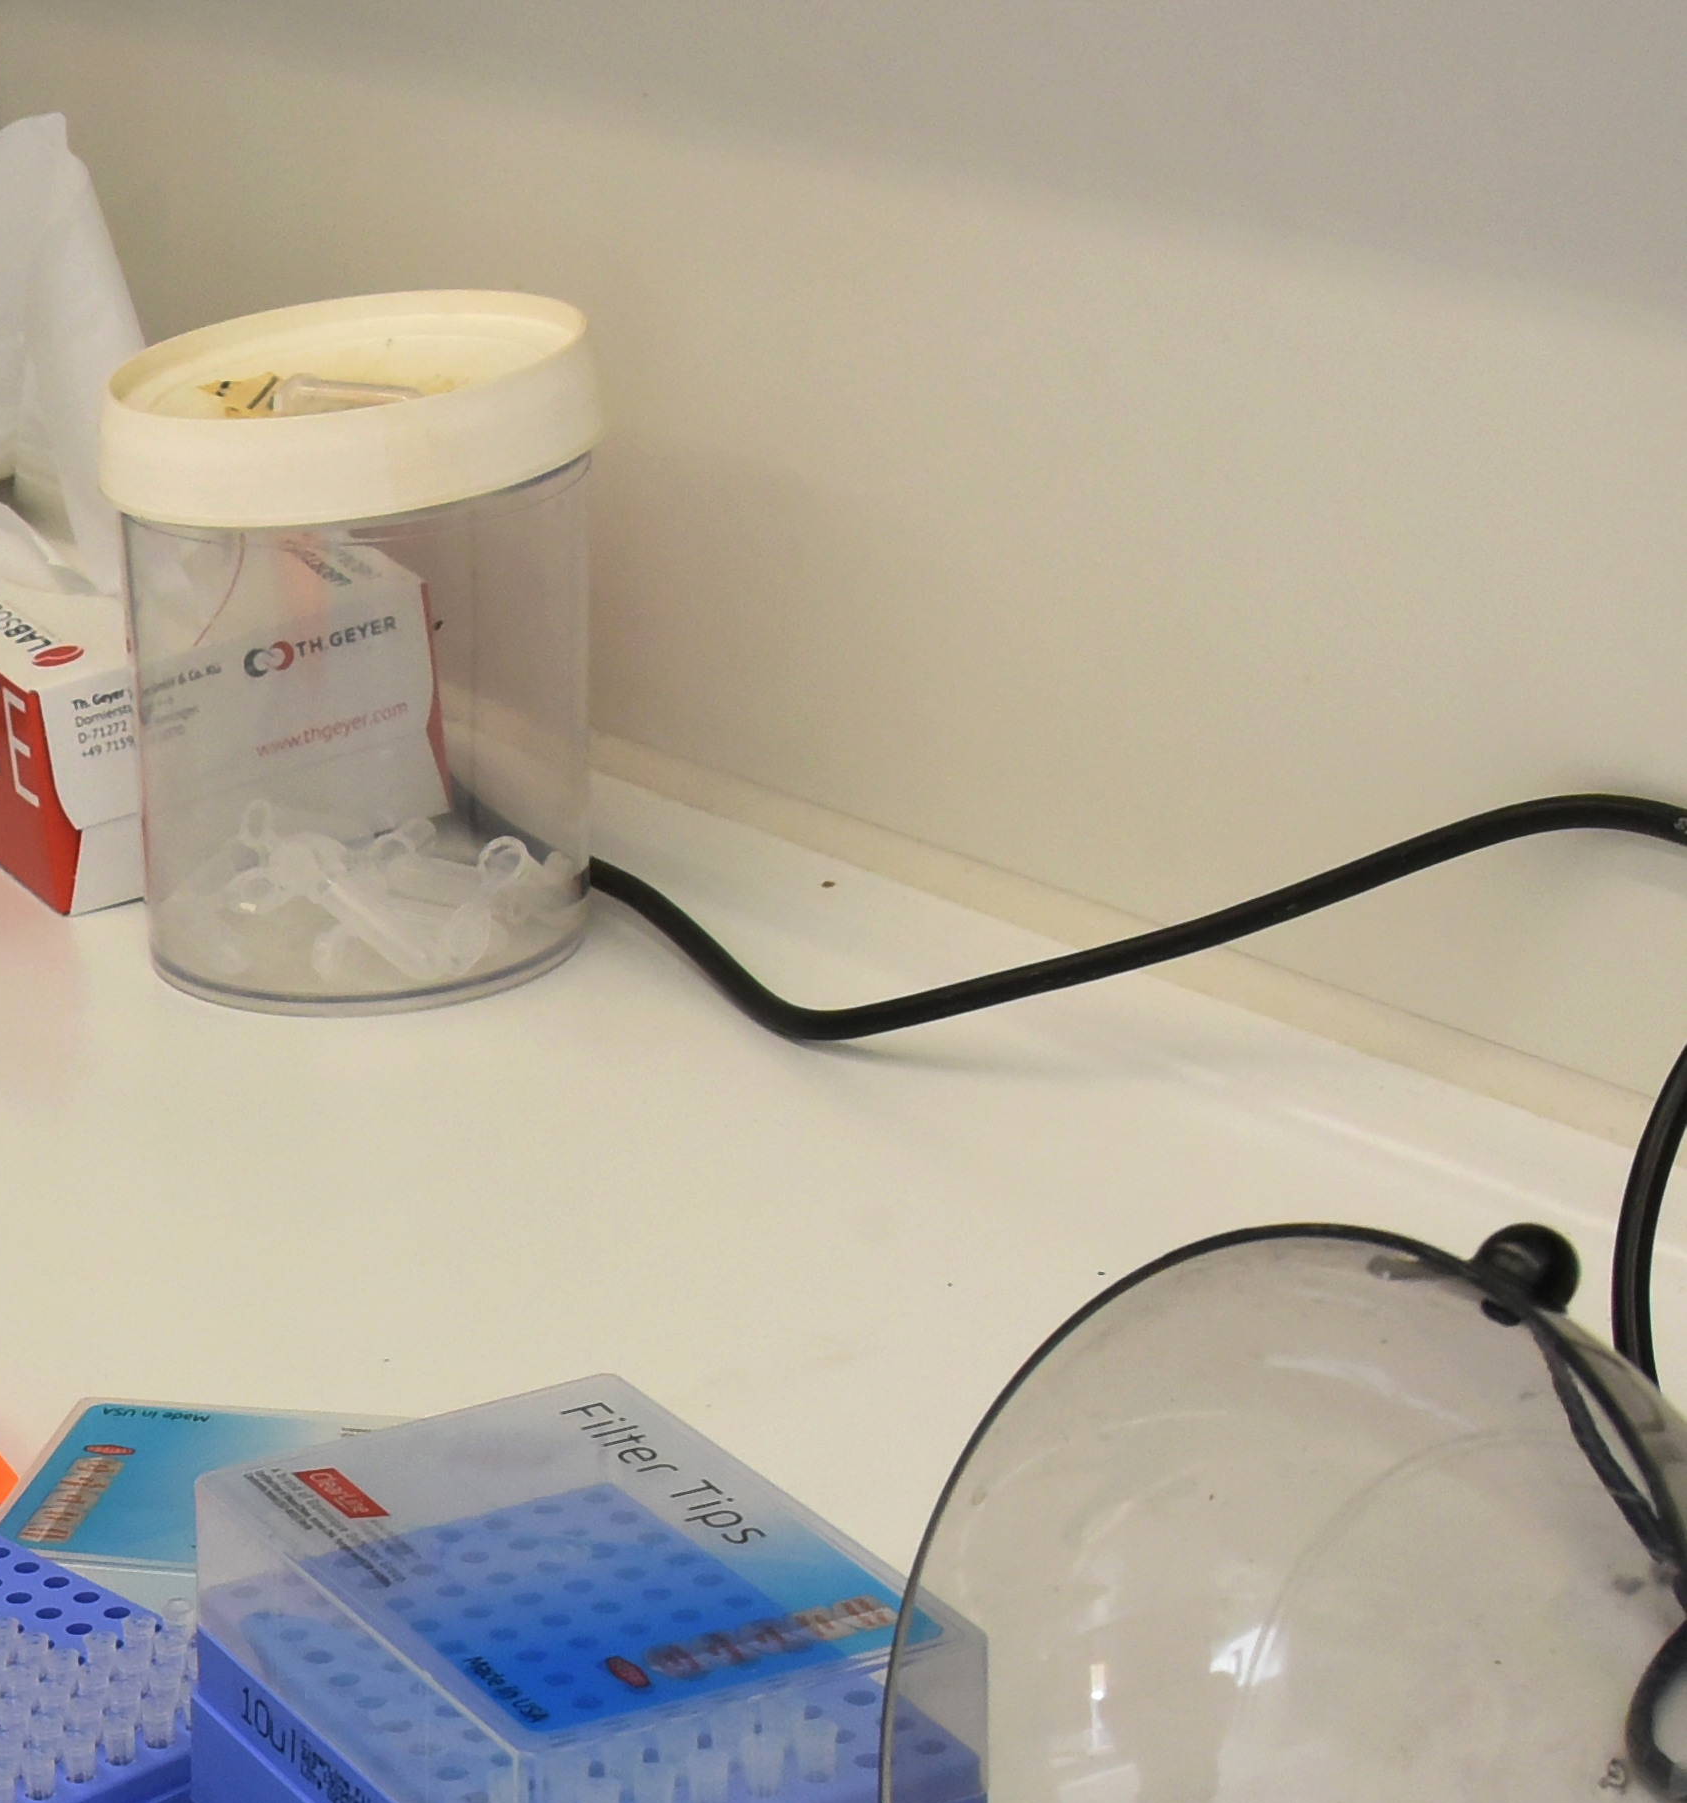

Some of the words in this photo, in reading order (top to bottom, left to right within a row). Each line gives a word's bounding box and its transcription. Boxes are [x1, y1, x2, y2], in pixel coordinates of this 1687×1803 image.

[255, 702, 408, 757] www.thgeyer.com
[102, 1405, 136, 1418] USA
[142, 1409, 158, 1419] in
[162, 1411, 211, 1424] Made
[559, 1401, 679, 1473] Filter
[669, 1478, 767, 1545] Tips
